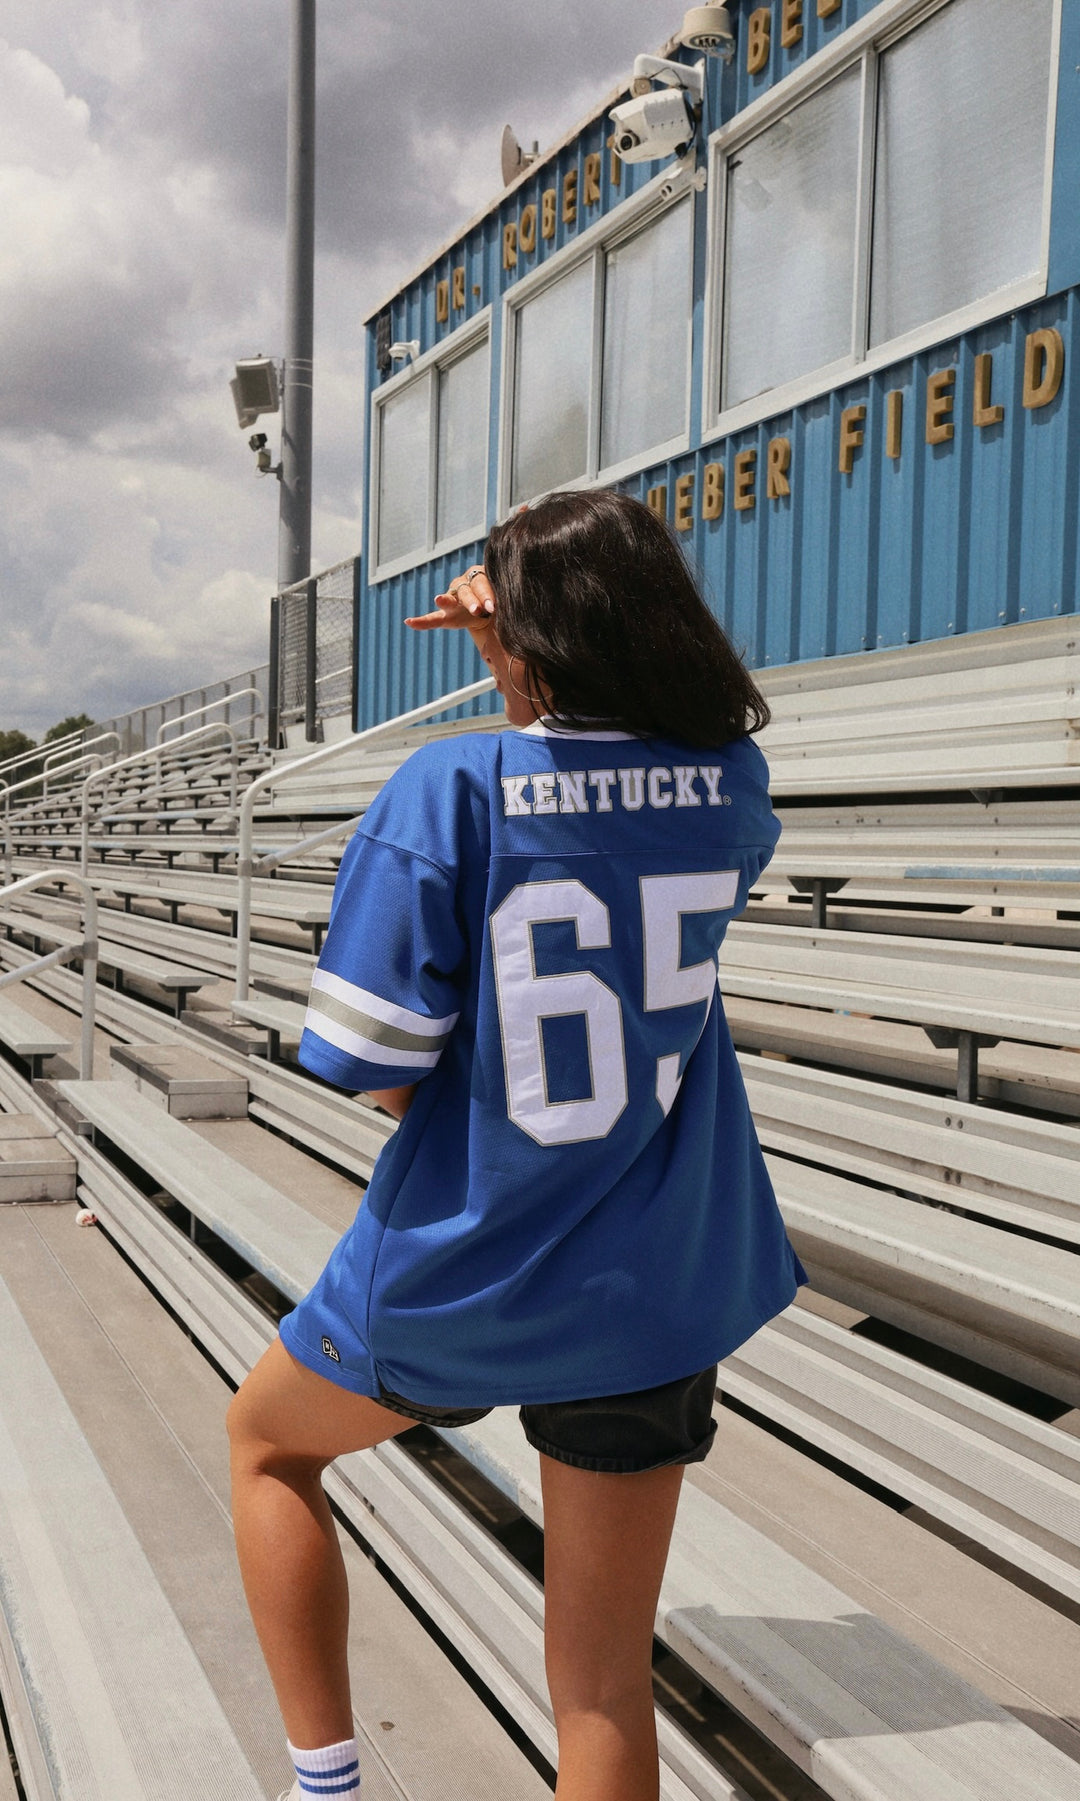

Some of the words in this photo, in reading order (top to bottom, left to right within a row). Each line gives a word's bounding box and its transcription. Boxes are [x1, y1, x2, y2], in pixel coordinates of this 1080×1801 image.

[436, 266, 480, 323] DR.
[747, 0, 841, 75] BE
[838, 327, 1064, 474] FIELD
[489, 869, 740, 1147] 65
